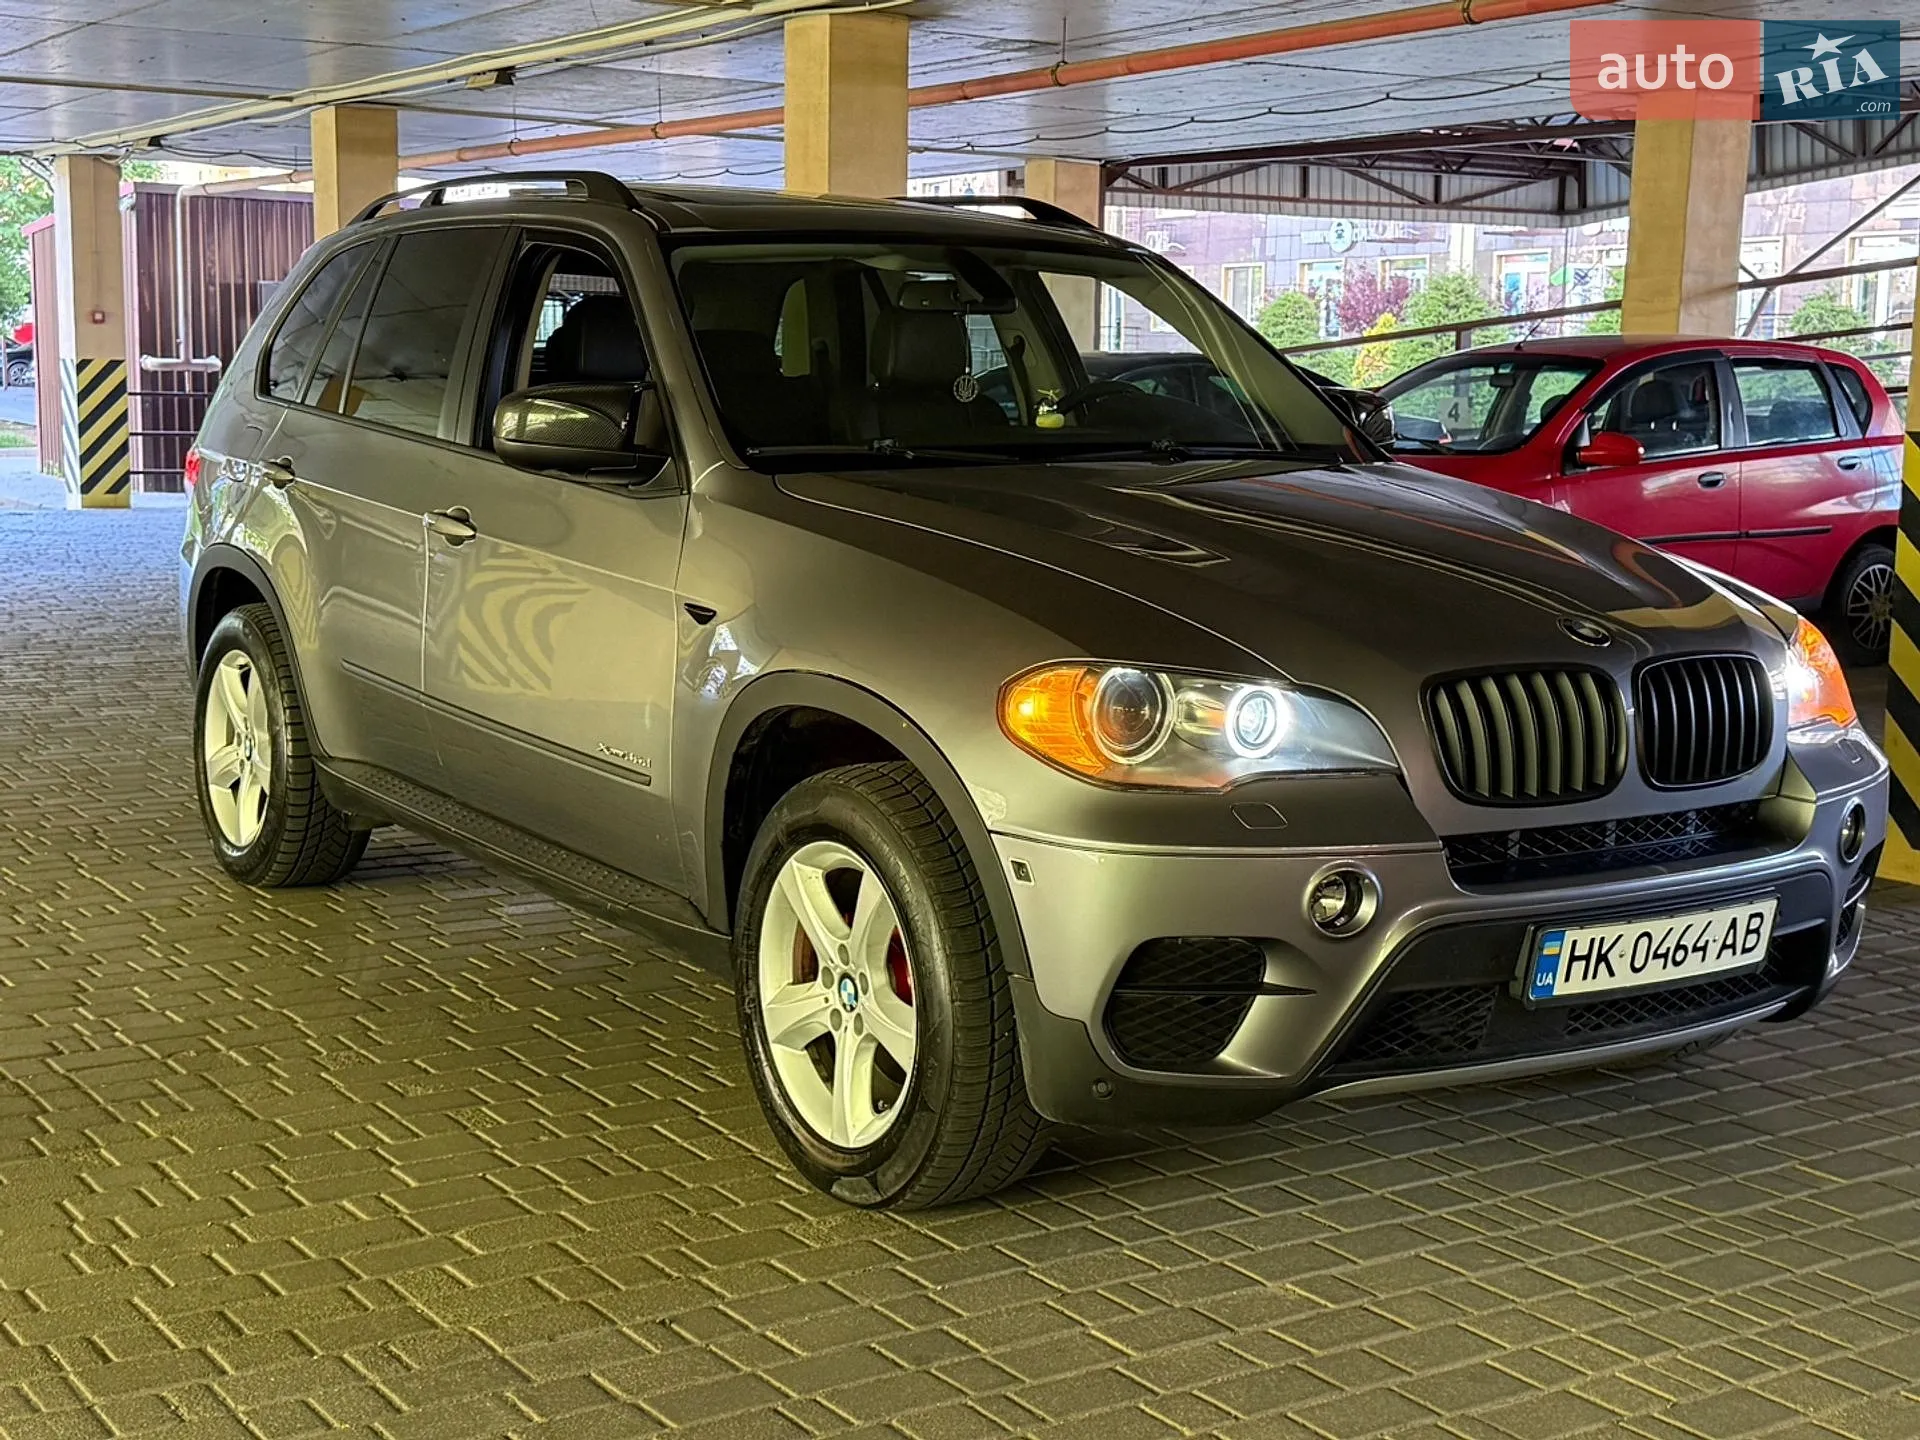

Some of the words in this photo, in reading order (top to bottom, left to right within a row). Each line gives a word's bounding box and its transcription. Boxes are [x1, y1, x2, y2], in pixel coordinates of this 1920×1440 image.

[1447, 401, 1461, 423] 4
[1563, 933, 1624, 983] HK
[1629, 919, 1714, 975] 0464
[1715, 911, 1765, 961] AB
[1536, 972, 1553, 987] UA
